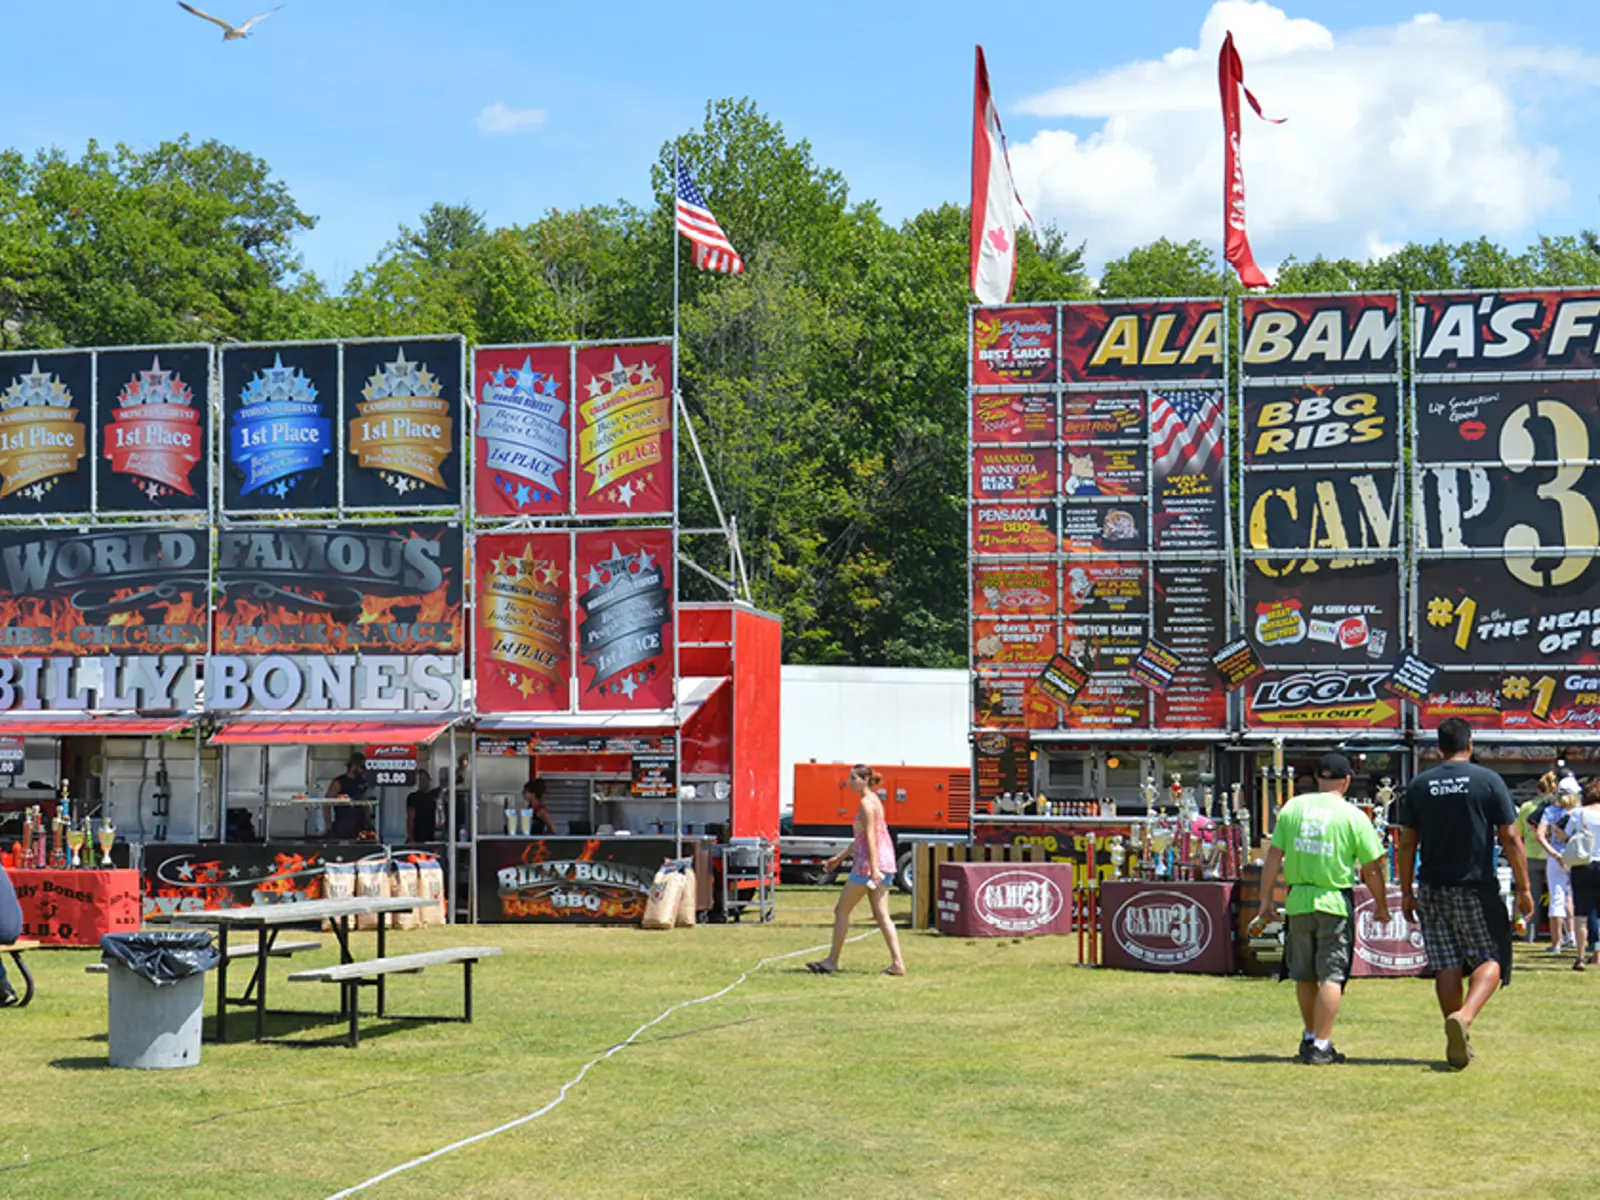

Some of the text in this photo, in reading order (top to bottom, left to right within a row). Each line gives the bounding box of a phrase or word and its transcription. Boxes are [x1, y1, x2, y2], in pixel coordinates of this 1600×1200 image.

[1547, 299, 1600, 355] F
[979, 348, 1051, 360] BEST SAUCE
[1257, 392, 1378, 427] BBQ
[1428, 402, 1446, 416] Lip
[0, 427, 74, 451] 1st Place
[116, 424, 191, 448] 1st Place
[241, 422, 320, 448] 1st Place
[361, 418, 441, 441] 1st Place
[1254, 415, 1385, 455] RIBS
[490, 448, 555, 477] 1st PLACE
[597, 440, 660, 478] 1st PLACE
[981, 464, 1037, 474] MINNESOTA
[983, 453, 1035, 464] MANKATO
[1166, 473, 1209, 484] WALL
[1162, 485, 1213, 497] FLAME
[978, 508, 1048, 522] PENSACOLA
[1003, 521, 1031, 533] BBQ
[1249, 467, 1491, 578] CAMP
[3, 532, 443, 596] WORLD FAMOUS
[1311, 605, 1324, 615] AS
[1325, 605, 1347, 615] SEEN
[1348, 605, 1362, 614] ON
[71, 624, 208, 645] CHICKEN
[234, 623, 453, 645] PORK SAUCE
[1426, 596, 1477, 651] #1
[1477, 618, 1530, 641] THE
[1538, 630, 1582, 654] OF
[493, 640, 557, 669] 1st PLACE
[0, 654, 455, 711] BILLY BONES
[1250, 671, 1392, 710] LOOK
[1502, 675, 1556, 722] #1
[1564, 674, 1600, 692] Gra
[1311, 712, 1323, 720] IT
[376, 772, 407, 784] $3.00
[497, 864, 569, 892] BILLY
[42, 880, 94, 904] Bones
[551, 893, 601, 912] BBQ
[1125, 906, 1172, 936] CAMP
